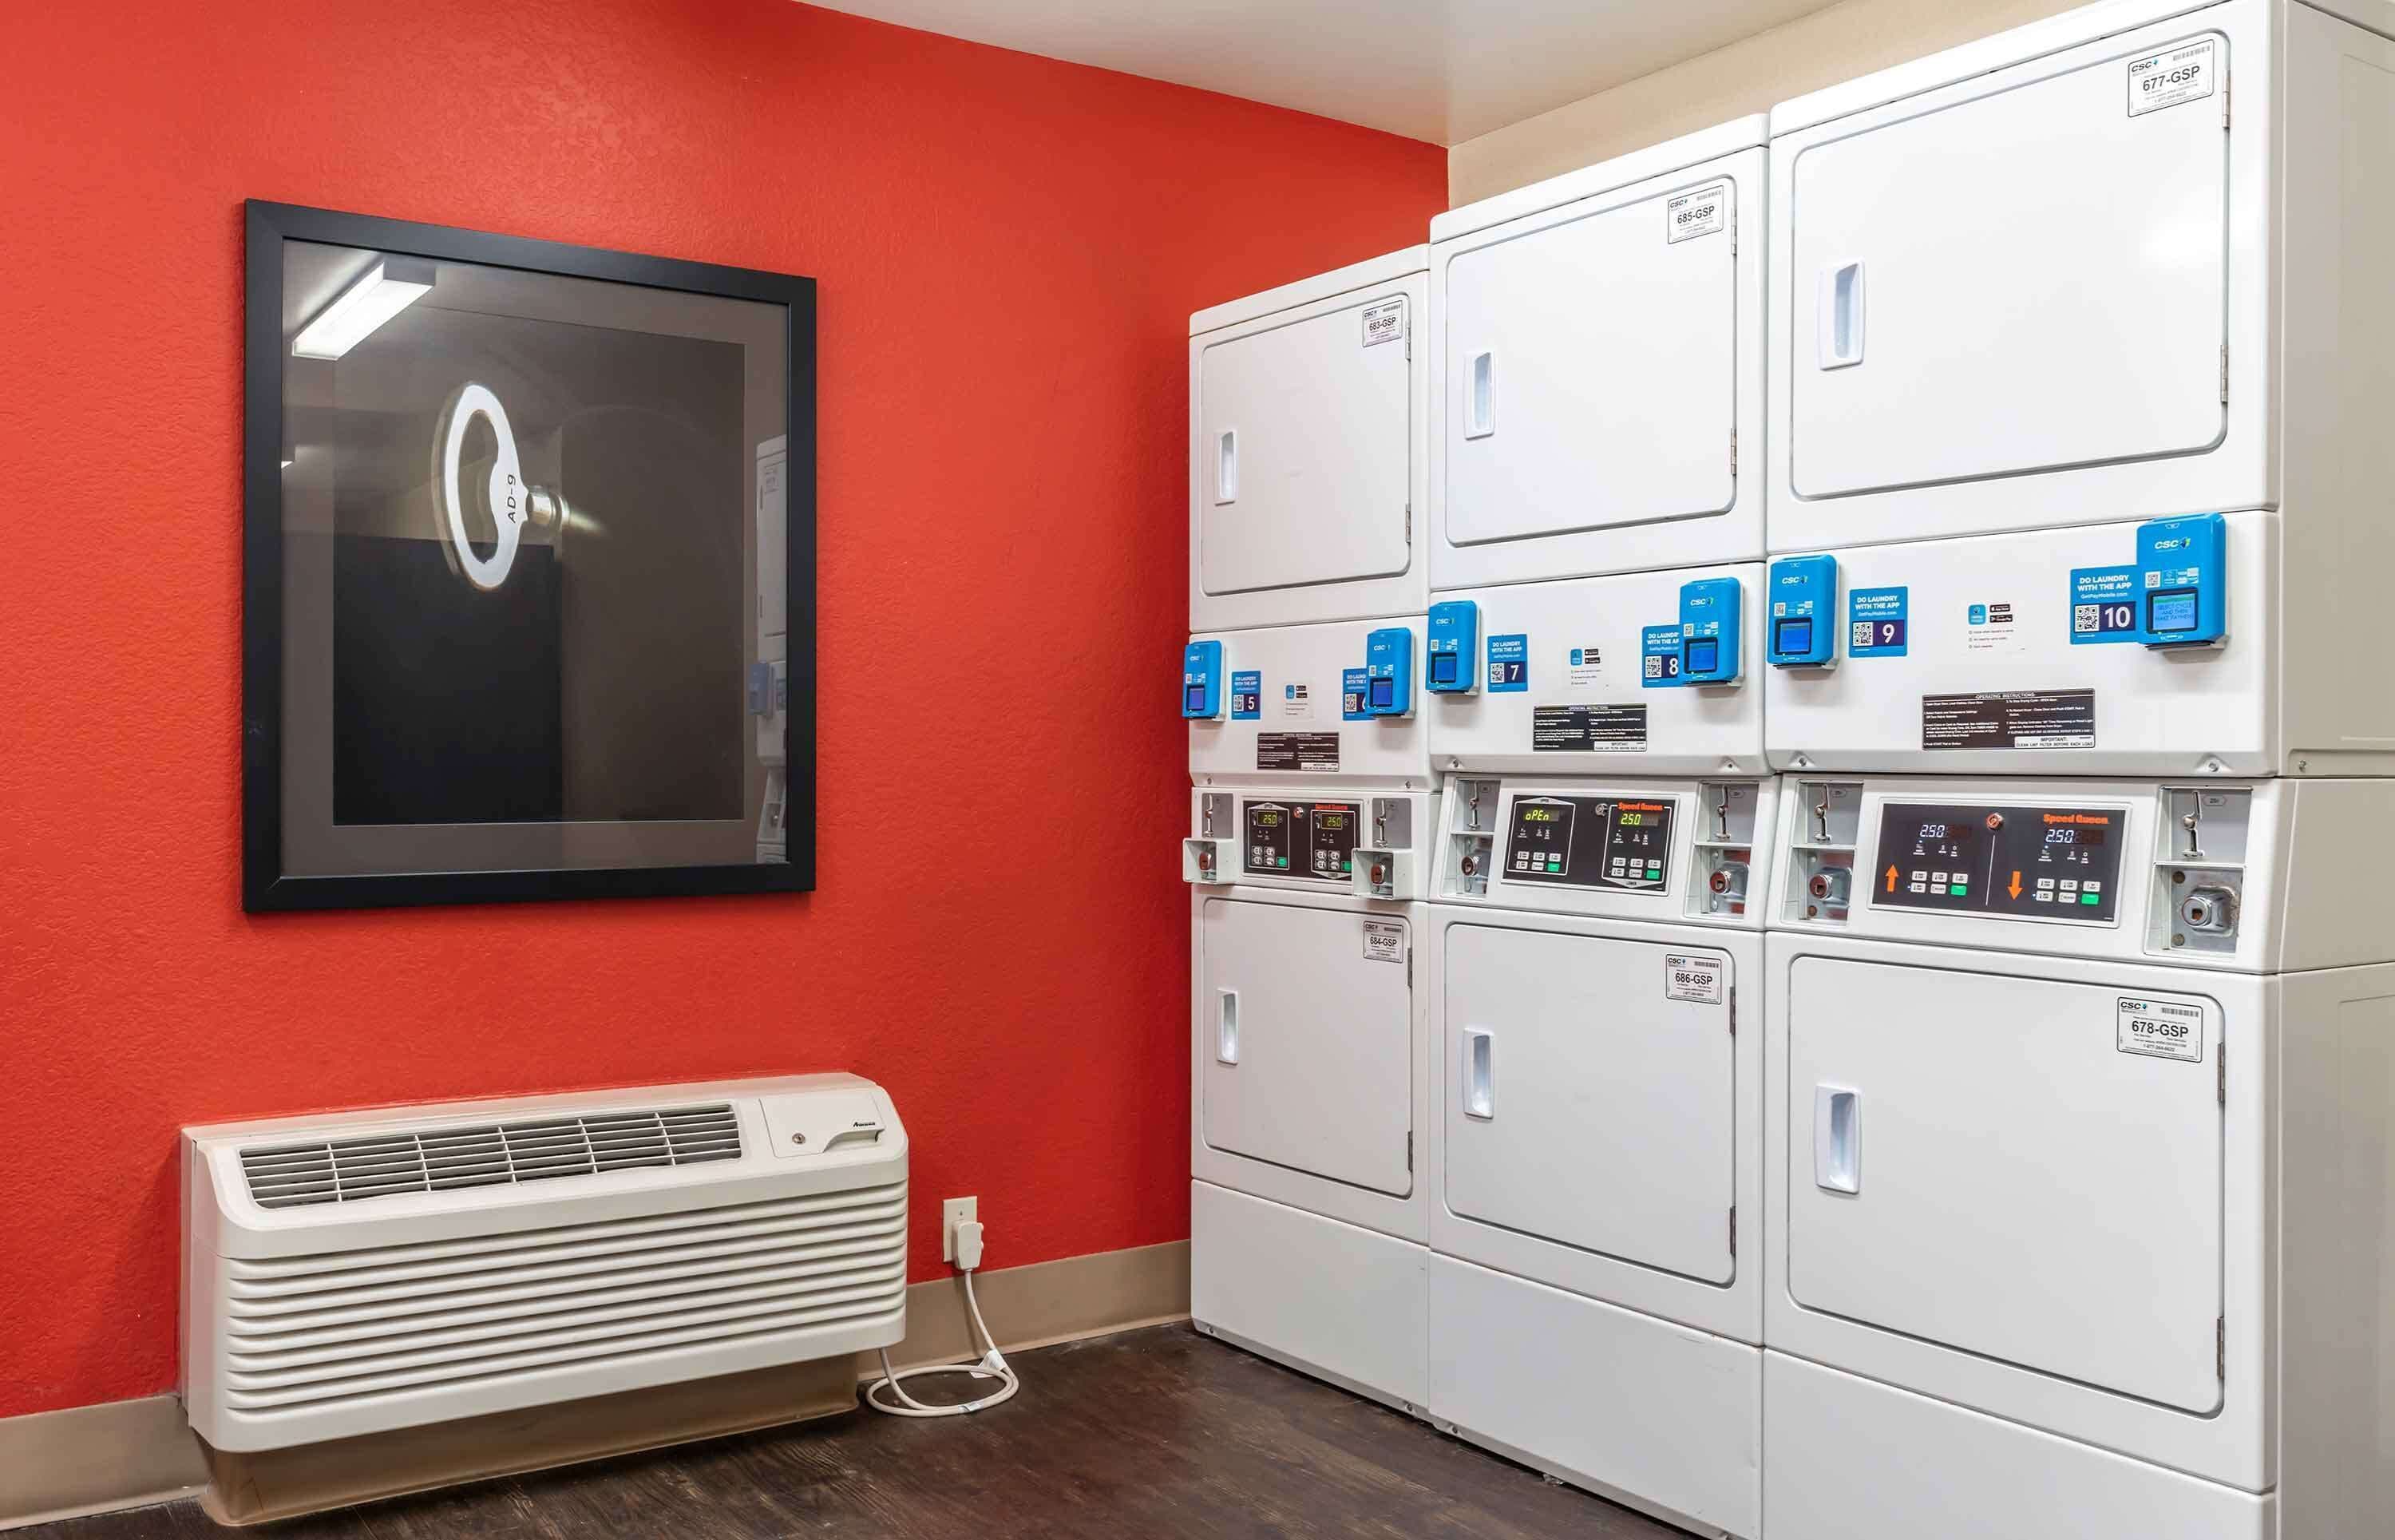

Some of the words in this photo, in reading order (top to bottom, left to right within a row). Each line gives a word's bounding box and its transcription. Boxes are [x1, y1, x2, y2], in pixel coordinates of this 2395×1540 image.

[2132, 61, 2152, 72] CSC
[2143, 65, 2200, 91] 677-GSP
[1670, 200, 1684, 208] CSC
[1677, 205, 1715, 224] 685-GSP
[1369, 317, 1396, 331] 683-GSP
[507, 474, 517, 524] AD-9
[2155, 540, 2179, 549] CSC
[2092, 574, 2130, 584] LAUNDRY
[1690, 598, 1706, 607] CSC
[2104, 606, 2131, 628] 10
[1882, 624, 1895, 643] 9
[1510, 664, 1519, 682] 7
[1669, 657, 1679, 676] 8
[1247, 696, 1256, 711] 5
[1617, 802, 1641, 811] Speed
[1641, 802, 1663, 811] Queen
[2043, 814, 2075, 824] Speed
[2075, 814, 2109, 825] Queen
[2045, 829, 2074, 844] 2.50
[1369, 936, 1397, 948] 684-GSP
[1675, 972, 1713, 985] 686-GSP
[2120, 1001, 2141, 1010] CSC
[2132, 1020, 2189, 1038] 678-GSP
